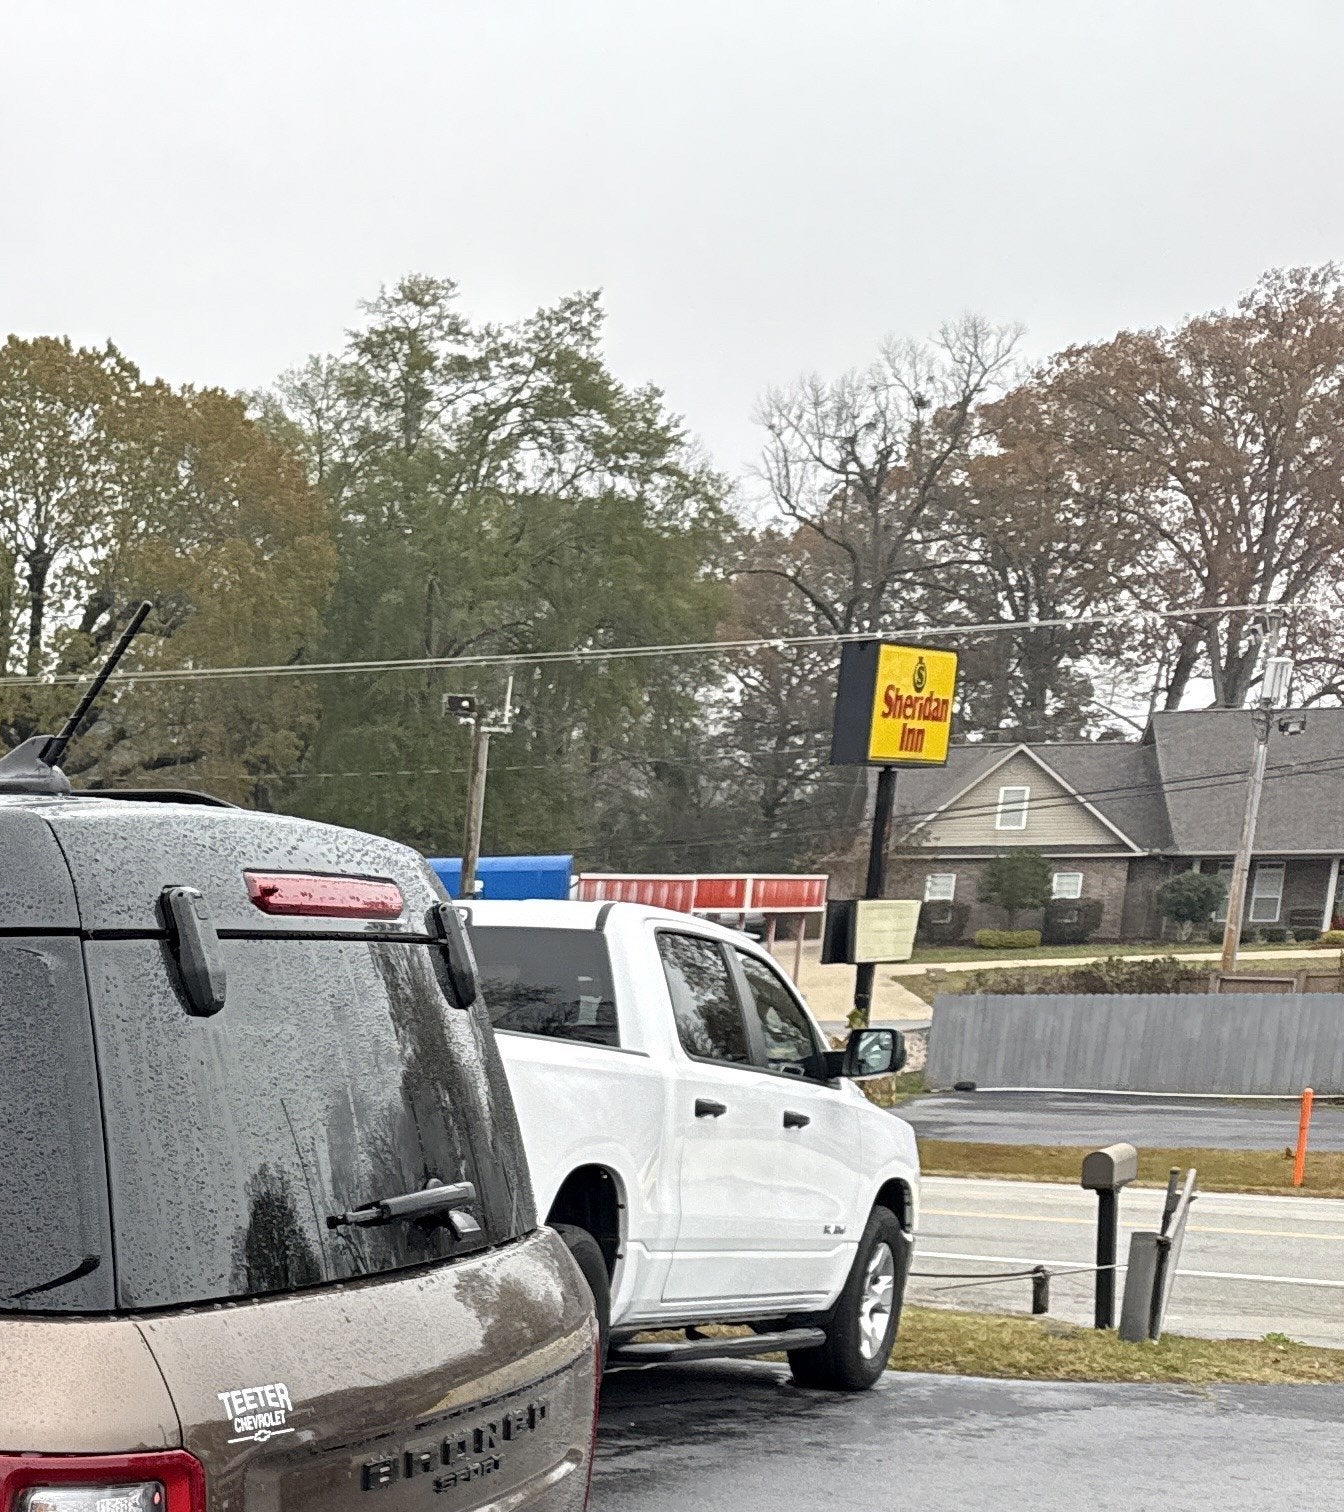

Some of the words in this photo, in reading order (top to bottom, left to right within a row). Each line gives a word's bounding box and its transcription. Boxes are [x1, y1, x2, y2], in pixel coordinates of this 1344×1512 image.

[881, 684, 950, 722] Sheridan
[899, 722, 925, 753] Inn
[217, 1382, 293, 1421] TEETER
[234, 1409, 286, 1433] CHEVROLET
[361, 1395, 551, 1492] BRONCO
[431, 1453, 506, 1494] SPORT
